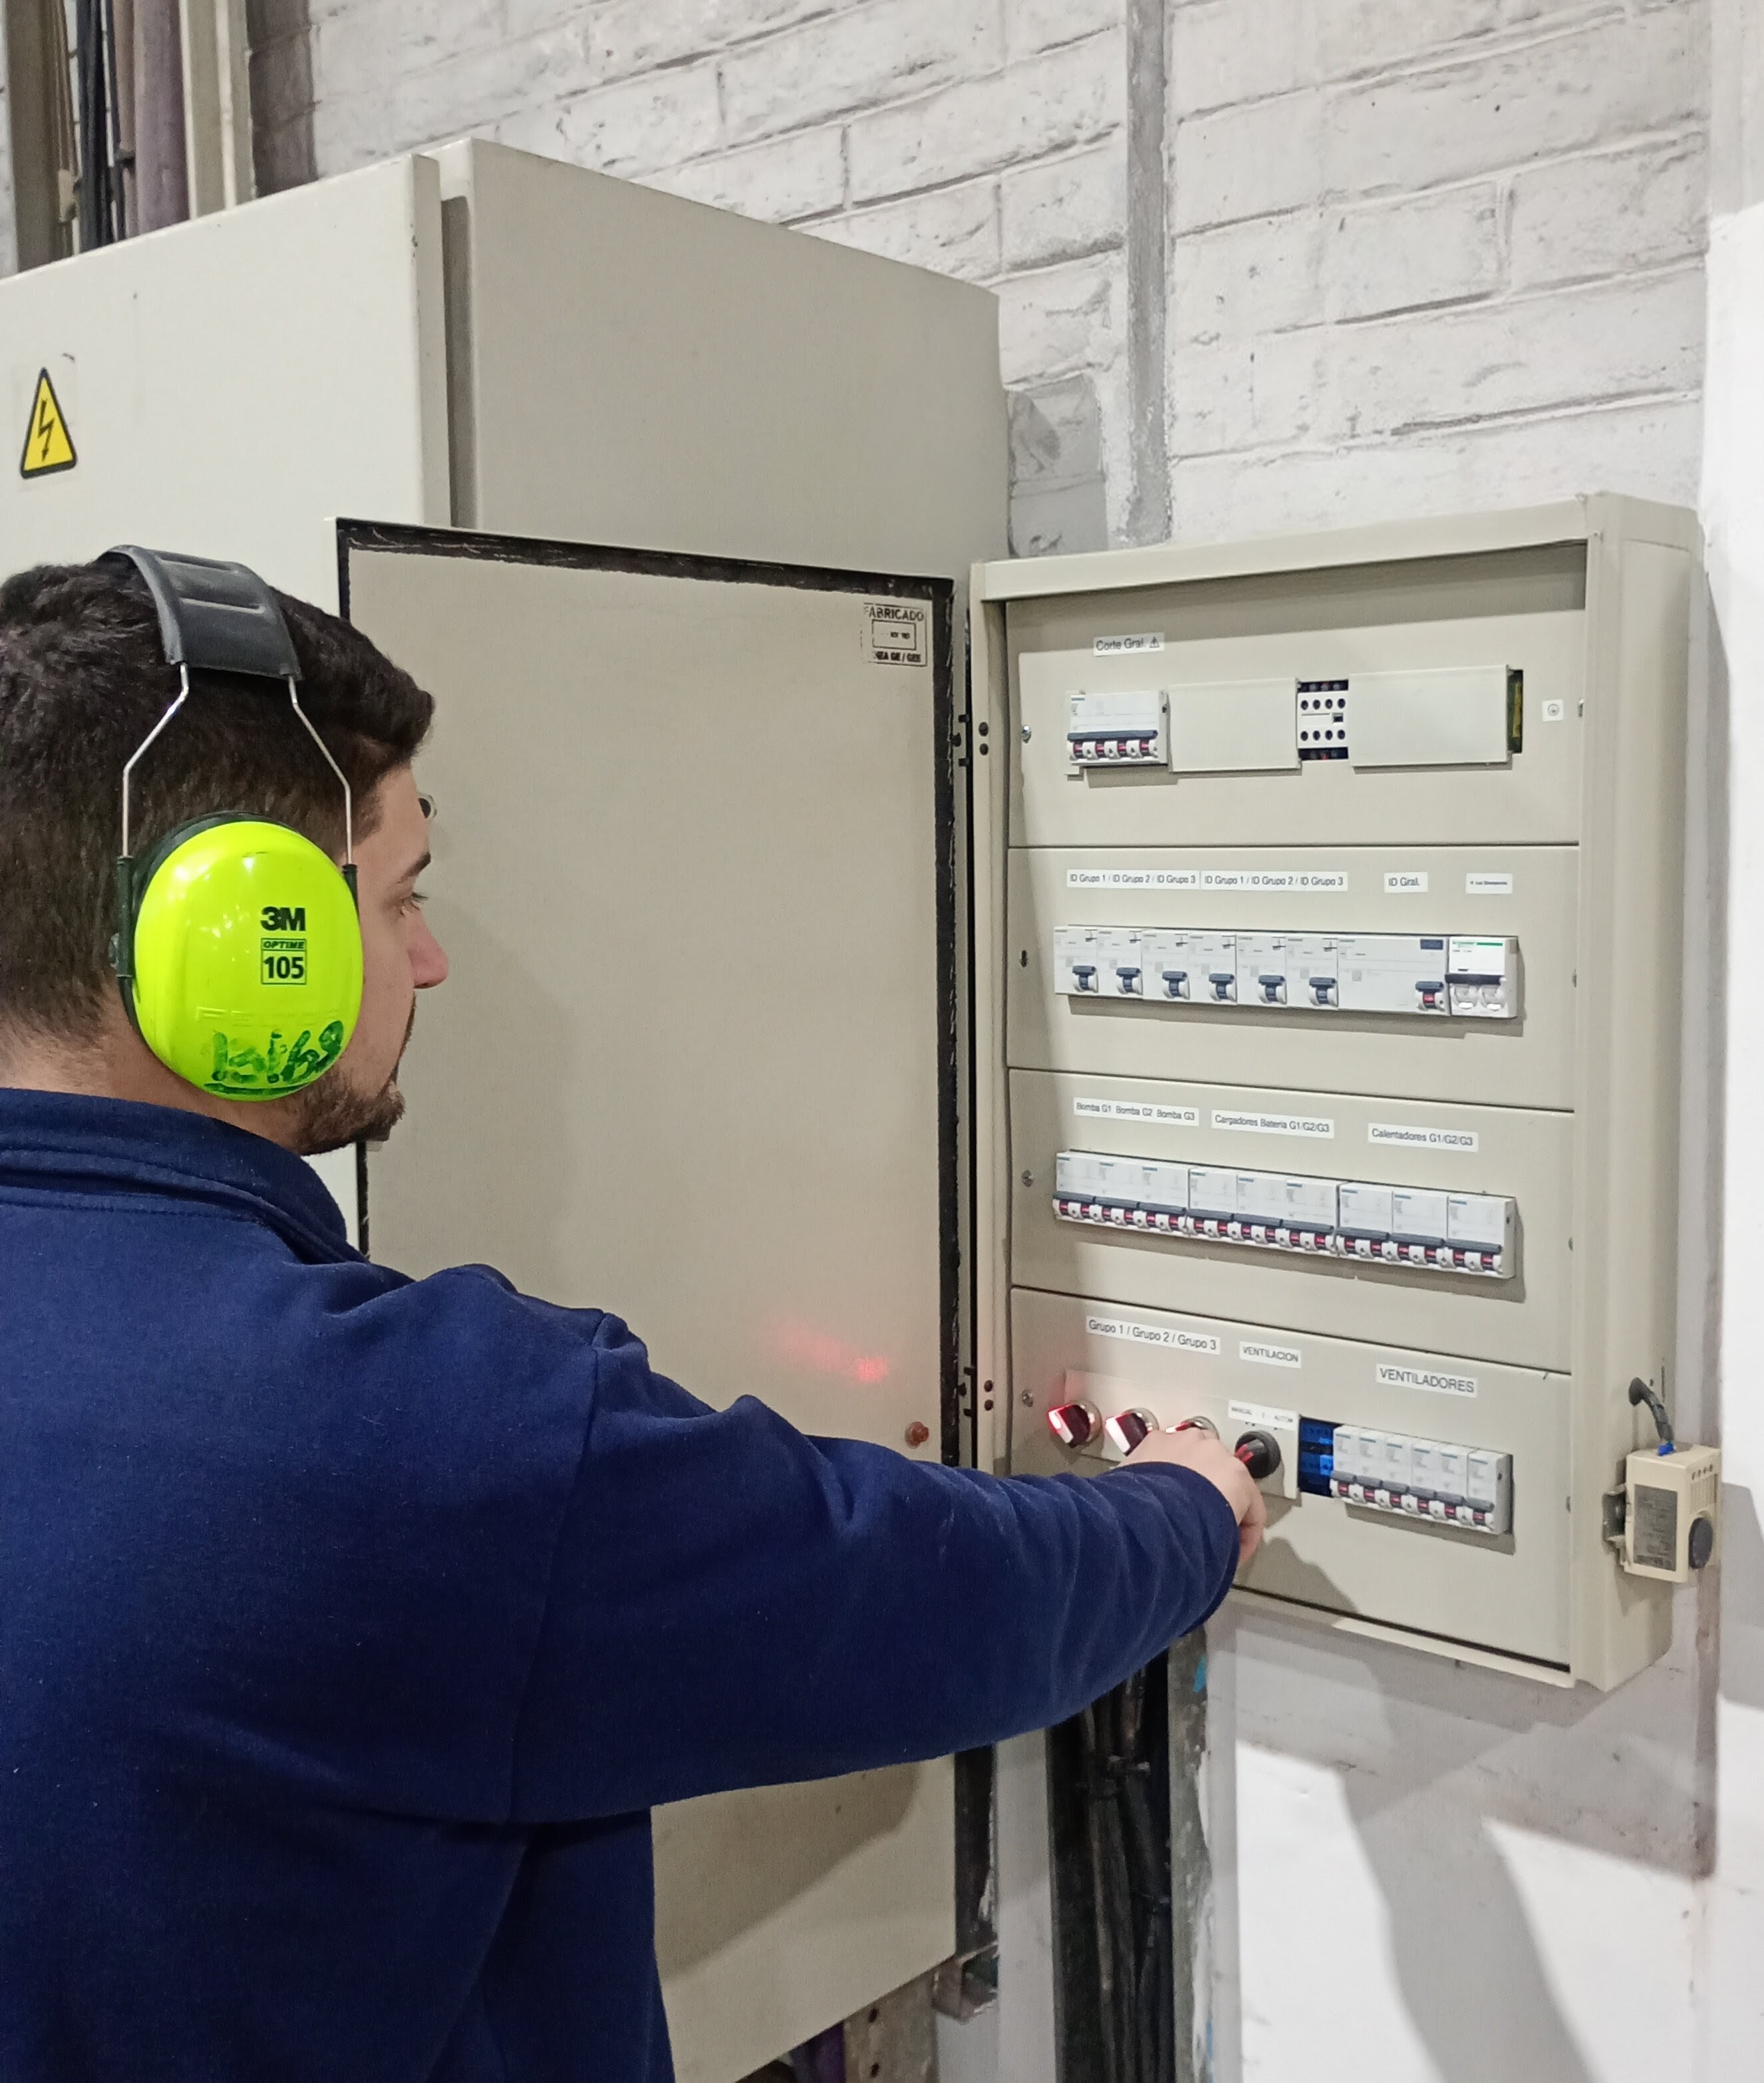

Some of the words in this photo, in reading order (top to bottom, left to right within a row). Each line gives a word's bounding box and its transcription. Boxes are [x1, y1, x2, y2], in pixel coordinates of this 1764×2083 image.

[864, 607, 924, 621] FABRICADO
[1096, 640, 1121, 650] Corte
[1070, 874, 1078, 883] ID
[1079, 874, 1100, 883] Grupo
[1113, 874, 1120, 883] ID
[1122, 874, 1144, 883] Grupo
[1157, 875, 1165, 883] ID
[1166, 875, 1189, 884] Grupo
[1190, 875, 1196, 884] 3
[1215, 875, 1238, 885] Grupo
[1251, 876, 1260, 885] ID
[1262, 876, 1286, 885] Grupo
[1288, 877, 1293, 885] 2
[1300, 877, 1308, 886] ID
[1311, 877, 1336, 887] Grupo
[1338, 877, 1344, 886] 3
[1388, 877, 1397, 887] ID
[260, 906, 306, 932] 3M
[263, 940, 305, 950] OPTIME
[263, 956, 304, 979] 105
[1076, 1102, 1100, 1112] Bomba
[1102, 1104, 1111, 1113] G1
[1115, 1105, 1140, 1115] Bomba
[1142, 1107, 1153, 1117] G2
[1156, 1109, 1181, 1119] Bomba
[1183, 1111, 1195, 1121] G3
[1215, 1115, 1258, 1127] Cargadores
[1372, 1128, 1427, 1141] Calentadores
[1088, 1319, 1116, 1333] Grupo
[1119, 1324, 1123, 1334] 1
[1133, 1327, 1161, 1341] Grupo
[1163, 1331, 1169, 1342] 2
[1178, 1334, 1207, 1349] Grupo
[1210, 1339, 1217, 1350] 3
[1380, 1367, 1475, 1393] VENTILADORES
